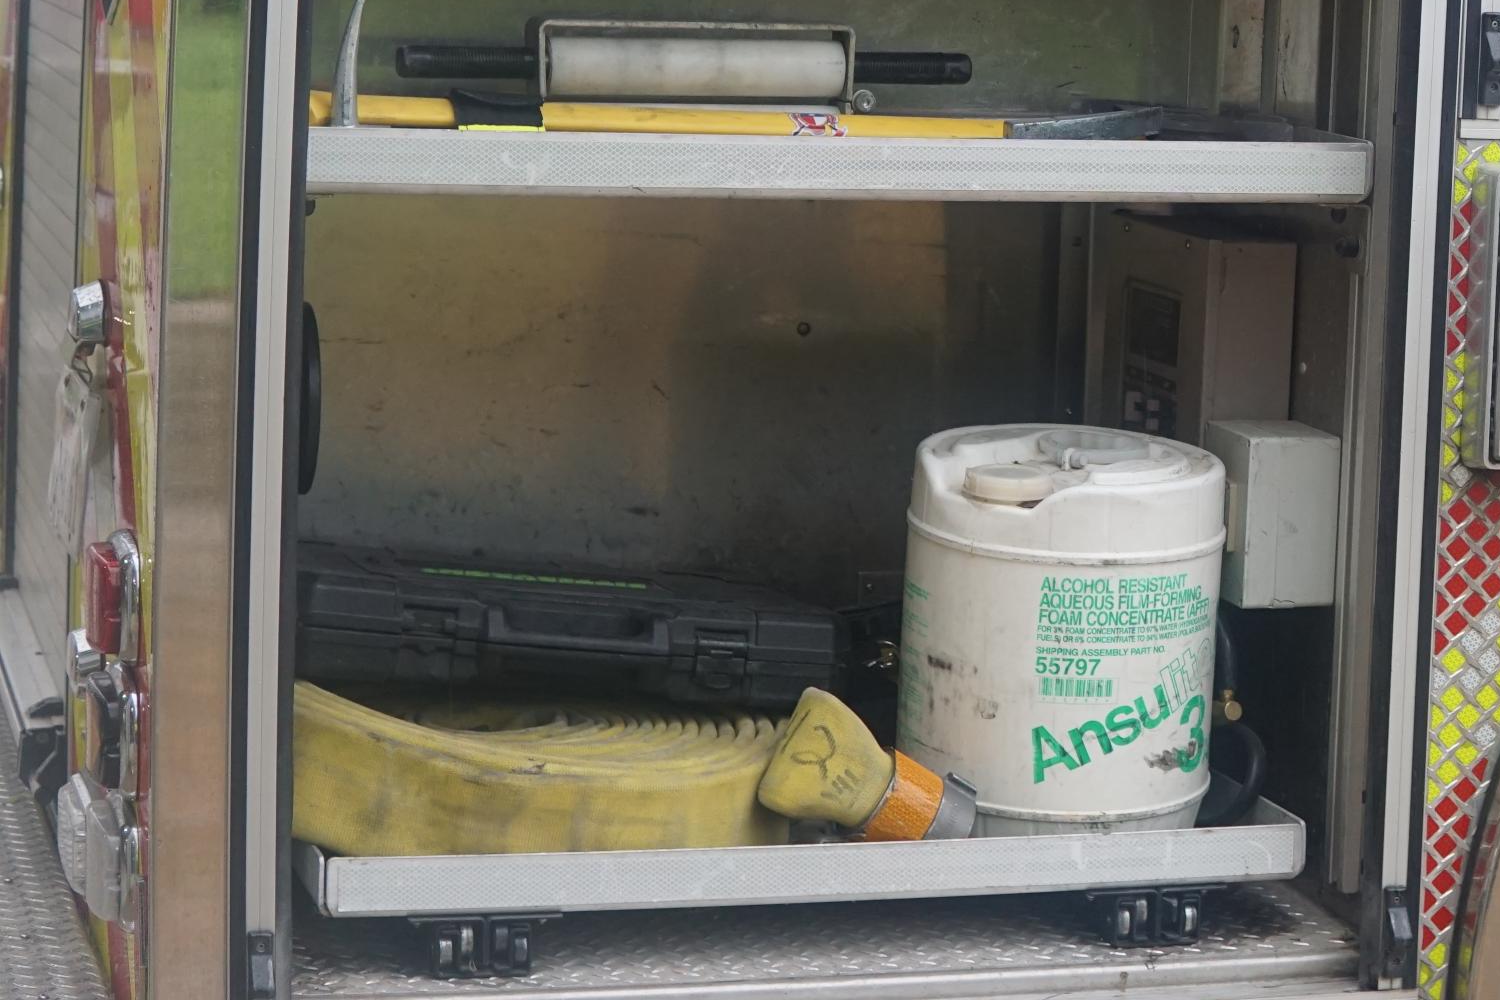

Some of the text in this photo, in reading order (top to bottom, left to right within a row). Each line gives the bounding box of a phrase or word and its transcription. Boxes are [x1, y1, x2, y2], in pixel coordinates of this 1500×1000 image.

[1040, 573, 1188, 594] ALCOHOL RESISTANT
[1039, 586, 1202, 610] AQUEOUS FILM-FORMING
[1038, 609, 1082, 626] FOAM
[1086, 605, 1185, 627] CONCENTRATE
[1037, 625, 1052, 633] FOR
[1086, 626, 1136, 635] CONCENTRATE
[1159, 622, 1178, 632] WATER
[1062, 635, 1074, 643] OR
[1086, 635, 1136, 644] CONCENTRATE
[1137, 634, 1146, 642] TO
[1158, 631, 1177, 641] WATER
[1036, 646, 1079, 657] SHIPPING
[1081, 647, 1129, 657] ASSEMBLY
[1131, 647, 1152, 656] PART
[1034, 656, 1101, 676] 55797
